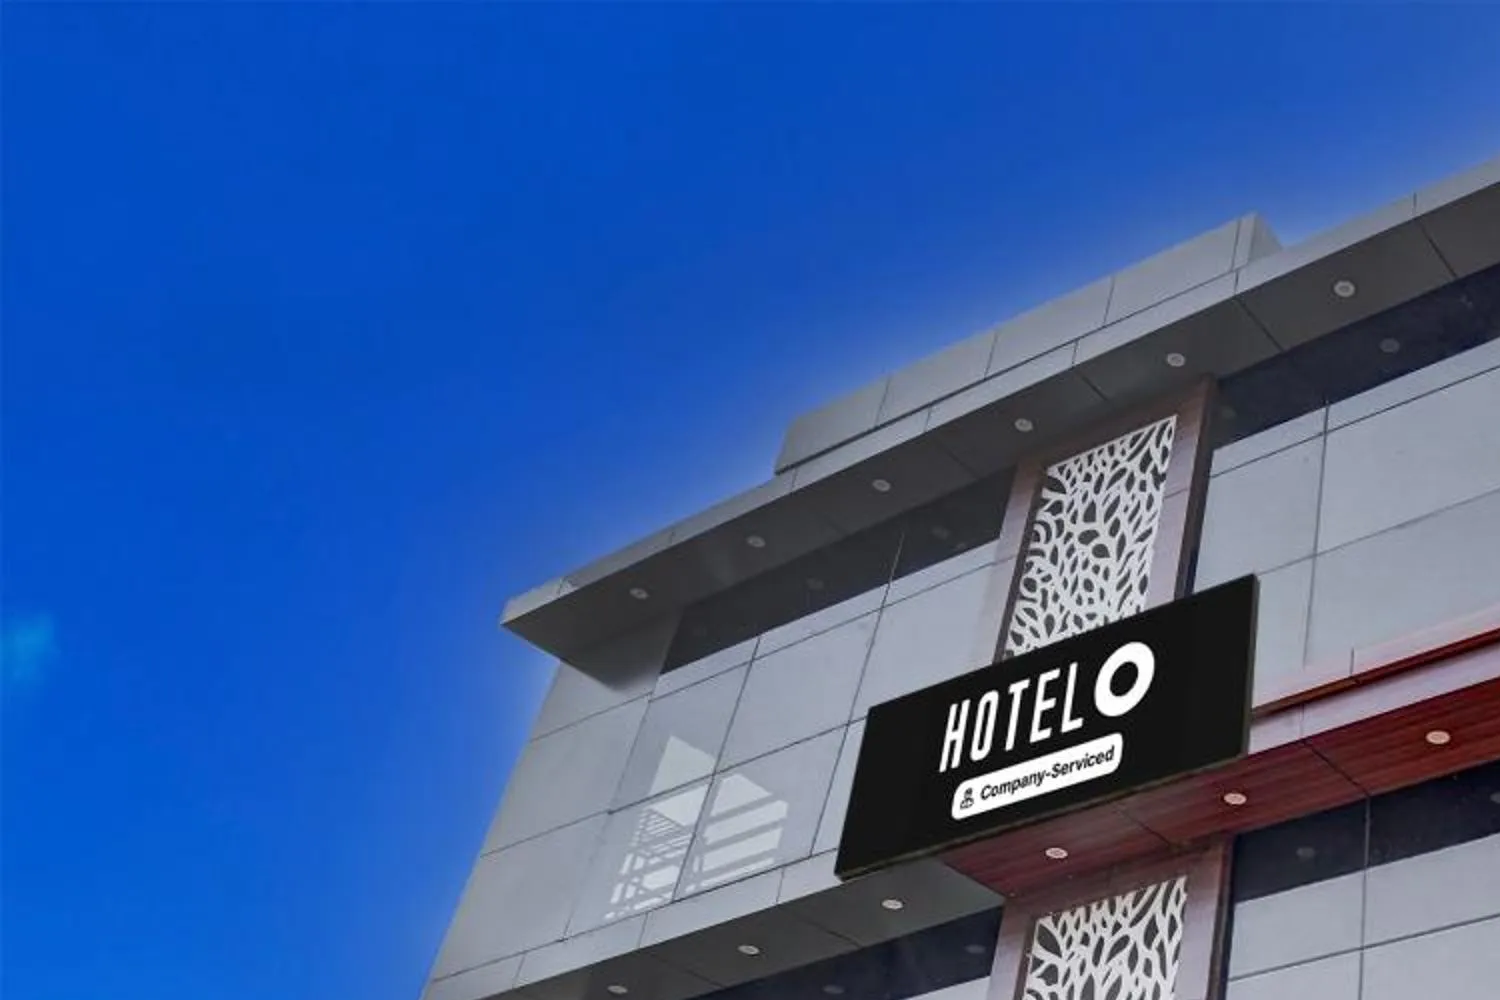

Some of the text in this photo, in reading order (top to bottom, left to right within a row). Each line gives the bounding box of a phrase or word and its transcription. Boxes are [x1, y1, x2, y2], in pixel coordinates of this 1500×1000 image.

[939, 641, 1155, 773] HOTEL O
[979, 744, 1115, 801] Company-Serviced
